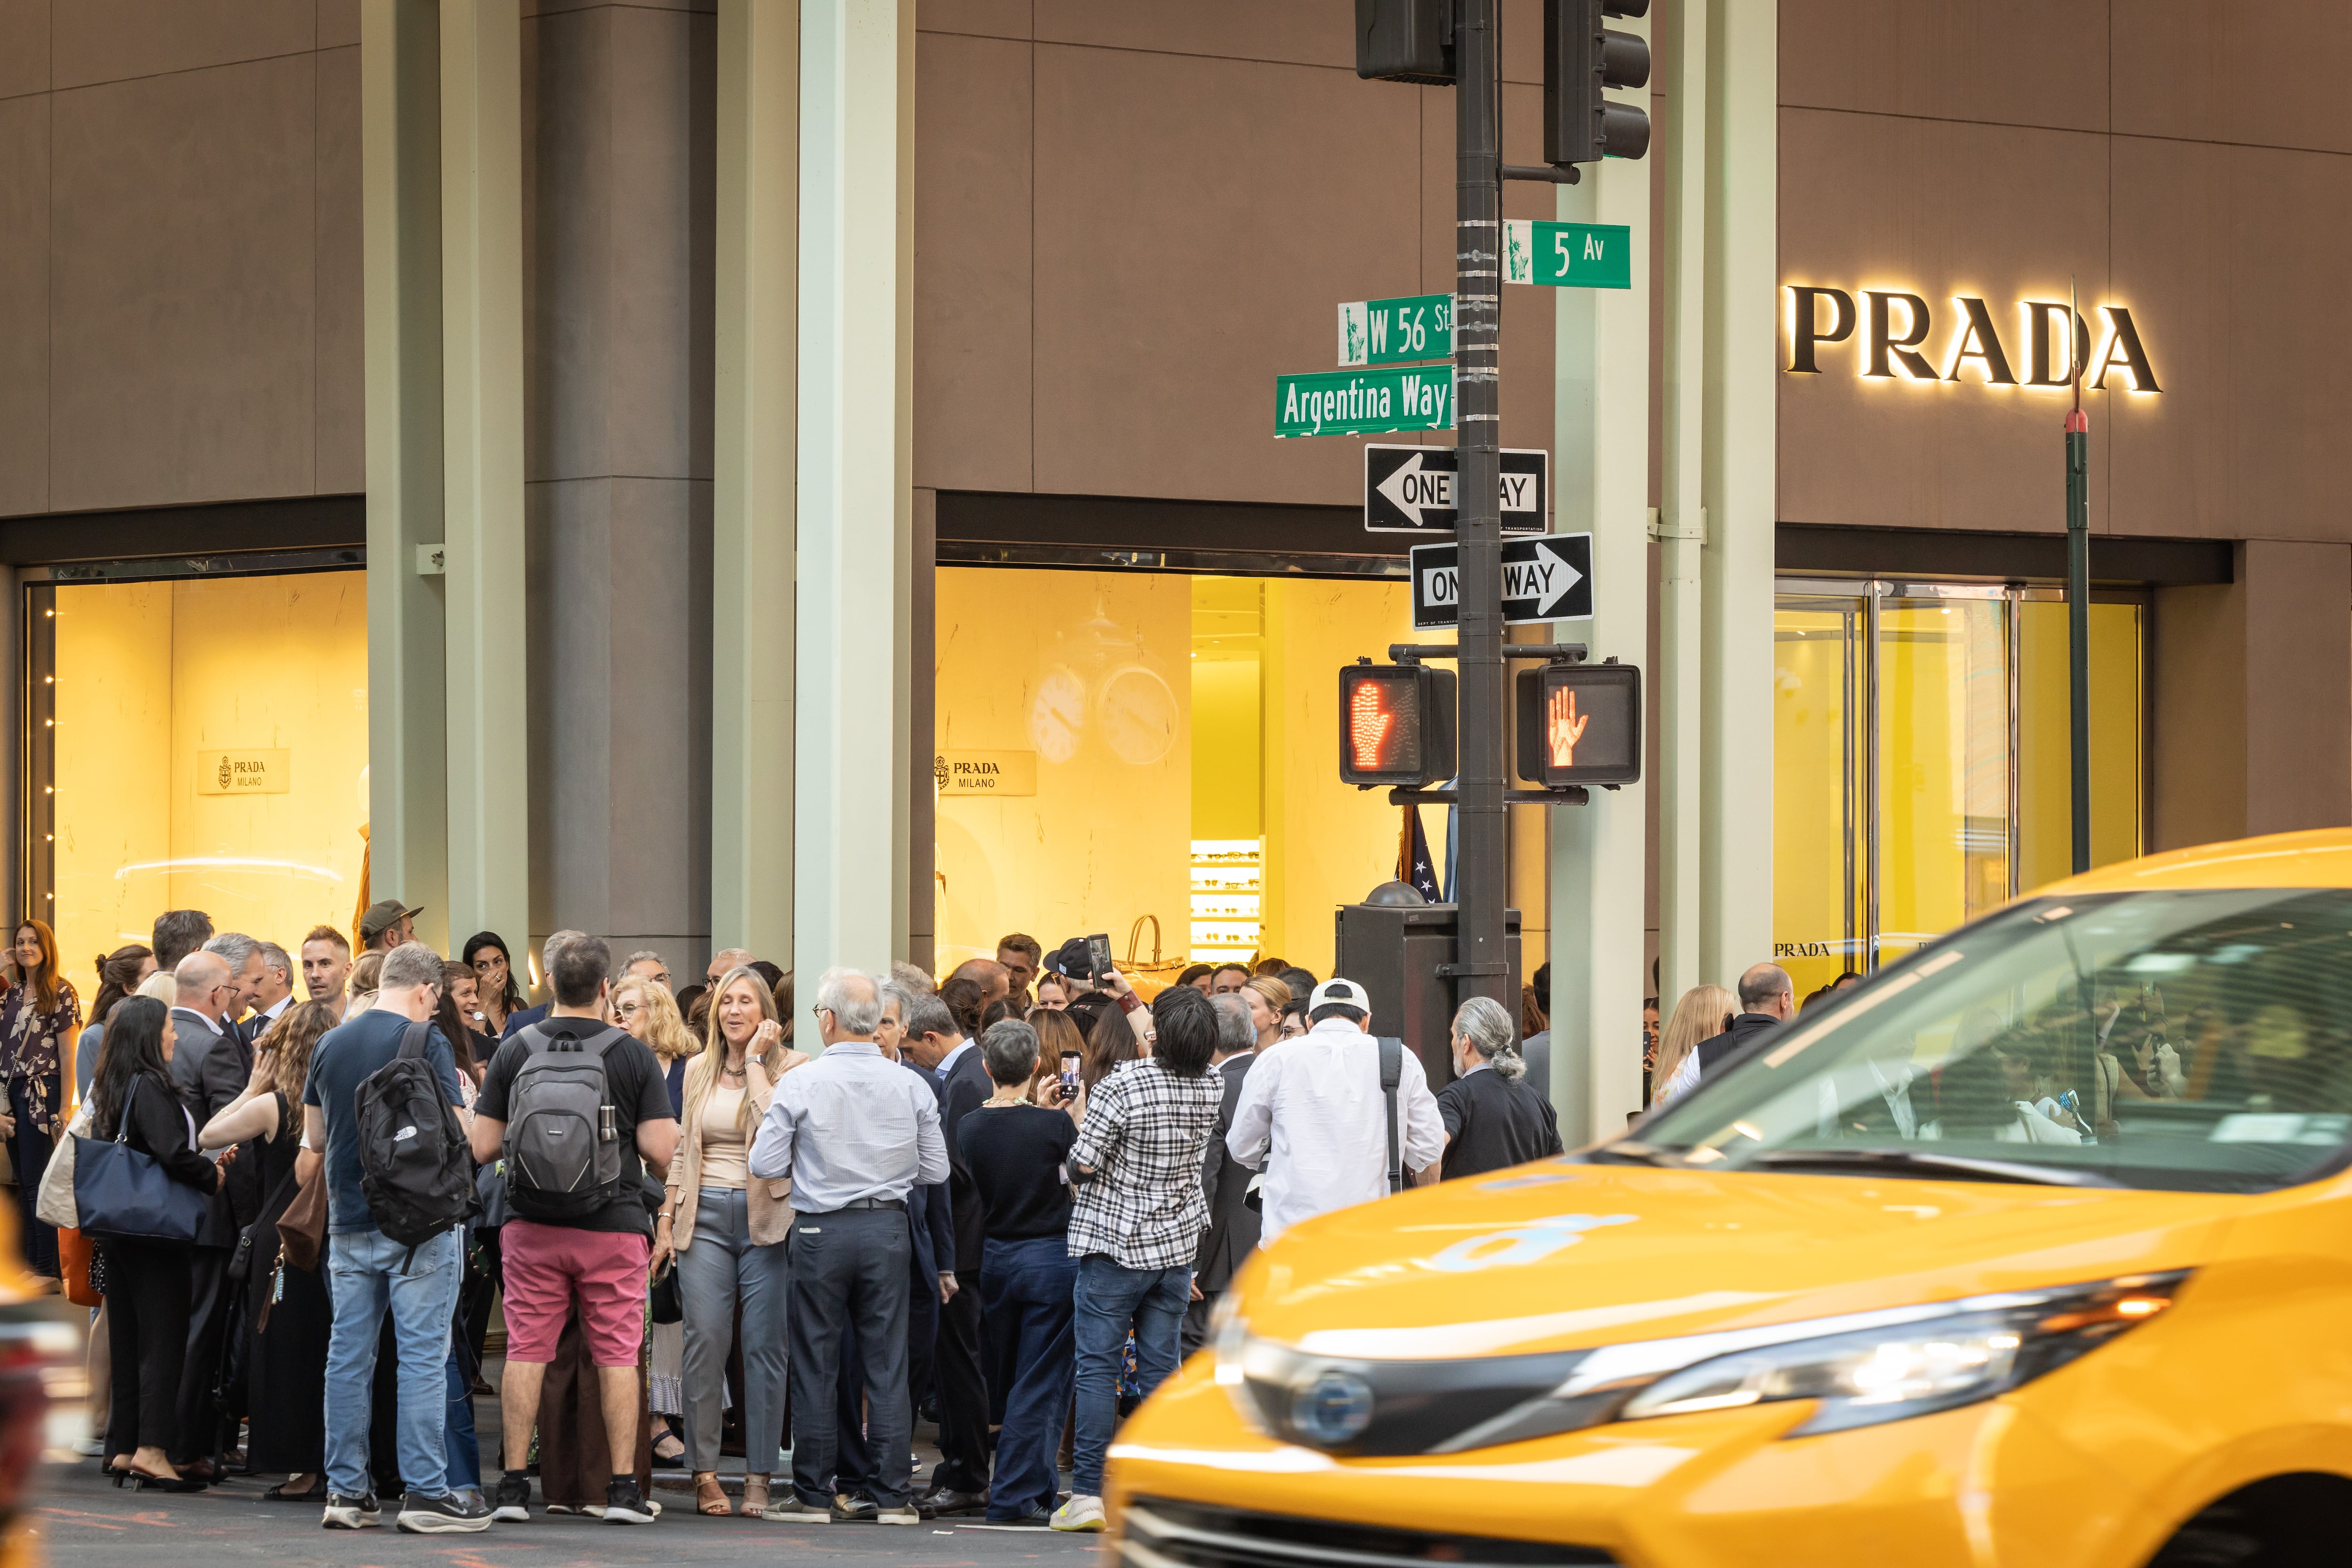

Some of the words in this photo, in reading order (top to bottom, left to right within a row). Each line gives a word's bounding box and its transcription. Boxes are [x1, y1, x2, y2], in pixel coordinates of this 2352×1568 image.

[1554, 231, 1571, 278] 5
[1583, 233, 1605, 261] Av
[1369, 309, 1389, 355] W
[1398, 306, 1426, 353] 56
[1434, 304, 1450, 333] St
[1782, 286, 2164, 393] PRADA
[1283, 378, 1391, 434] Argentina
[1402, 374, 1447, 426] Way
[1402, 474, 1451, 505] ONE
[1499, 477, 1527, 507] AY
[1432, 571, 1458, 602] ON
[1503, 563, 1556, 596] WAY
[234, 761, 265, 772] PRADA
[237, 777, 262, 786] MILANO
[954, 763, 1000, 774] PRADA
[959, 778, 995, 788] MILANO
[1774, 943, 1830, 956] PRADA
